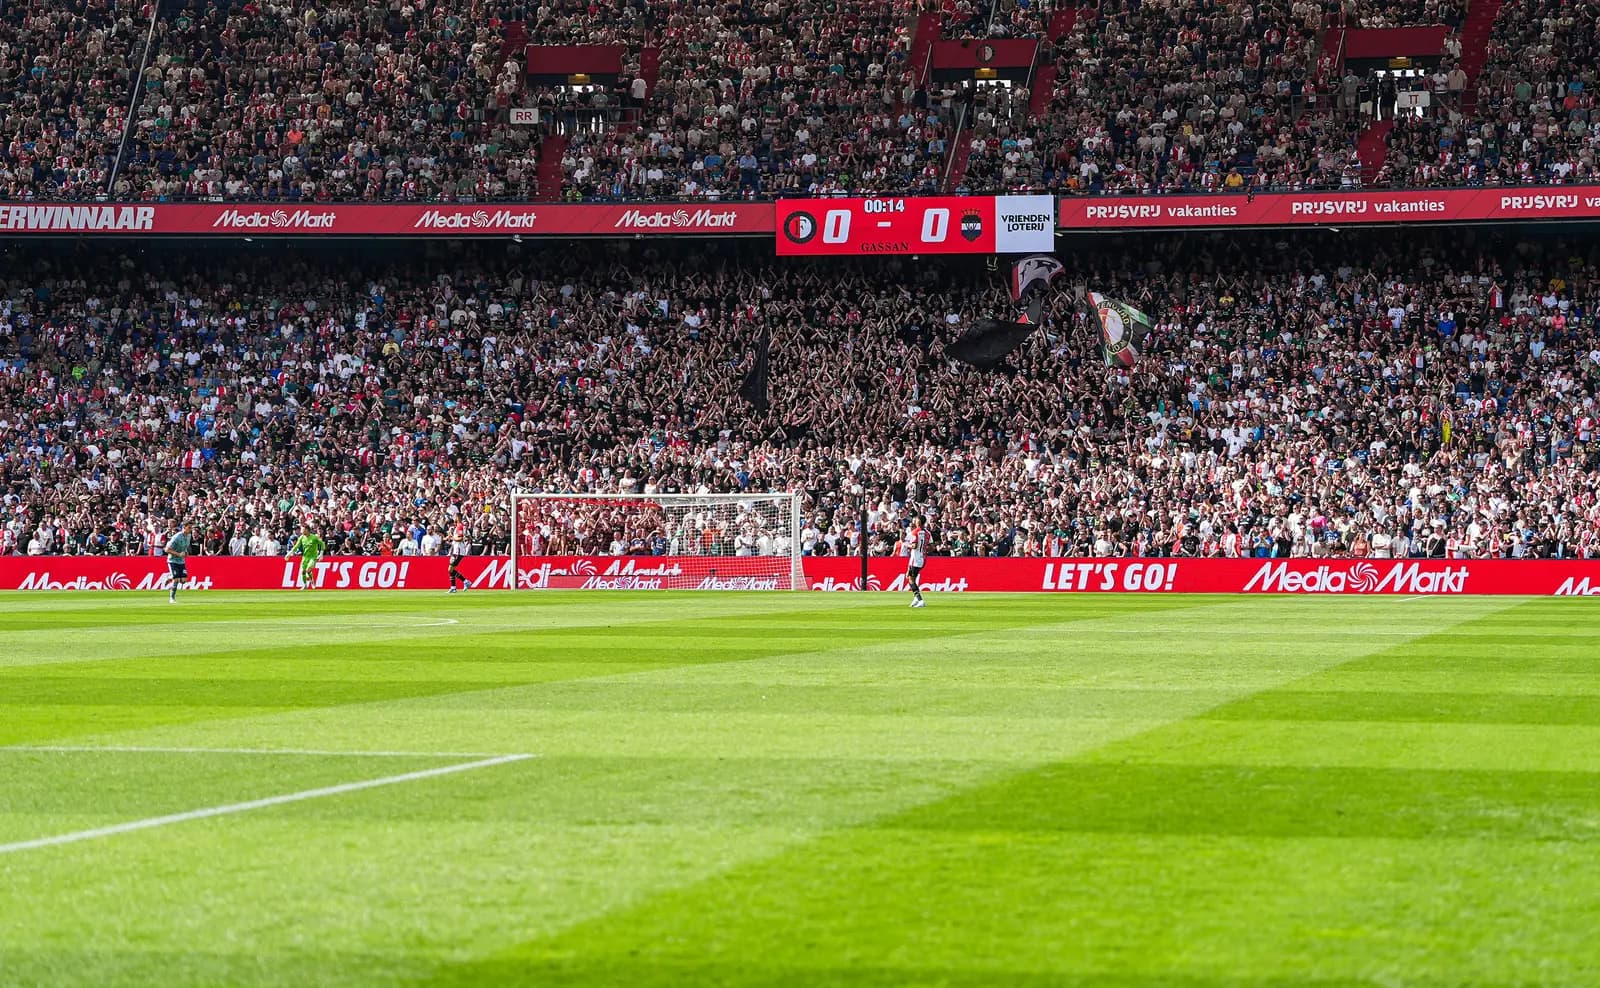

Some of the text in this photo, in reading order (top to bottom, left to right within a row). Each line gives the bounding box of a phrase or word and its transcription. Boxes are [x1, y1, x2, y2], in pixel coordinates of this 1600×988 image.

[515, 111, 533, 121] RR
[864, 199, 905, 213] 00:14
[1167, 204, 1238, 217] vakanties
[1374, 200, 1446, 213] vakanties
[1001, 214, 1050, 223] VRIENDEN
[823, 209, 852, 244] 0
[920, 208, 950, 243] 0
[1007, 222, 1045, 232] LOTERIJ
[861, 242, 909, 251] GASSAN
[358, 561, 410, 588] GO!
[1042, 563, 1178, 590] LET'S GO!
